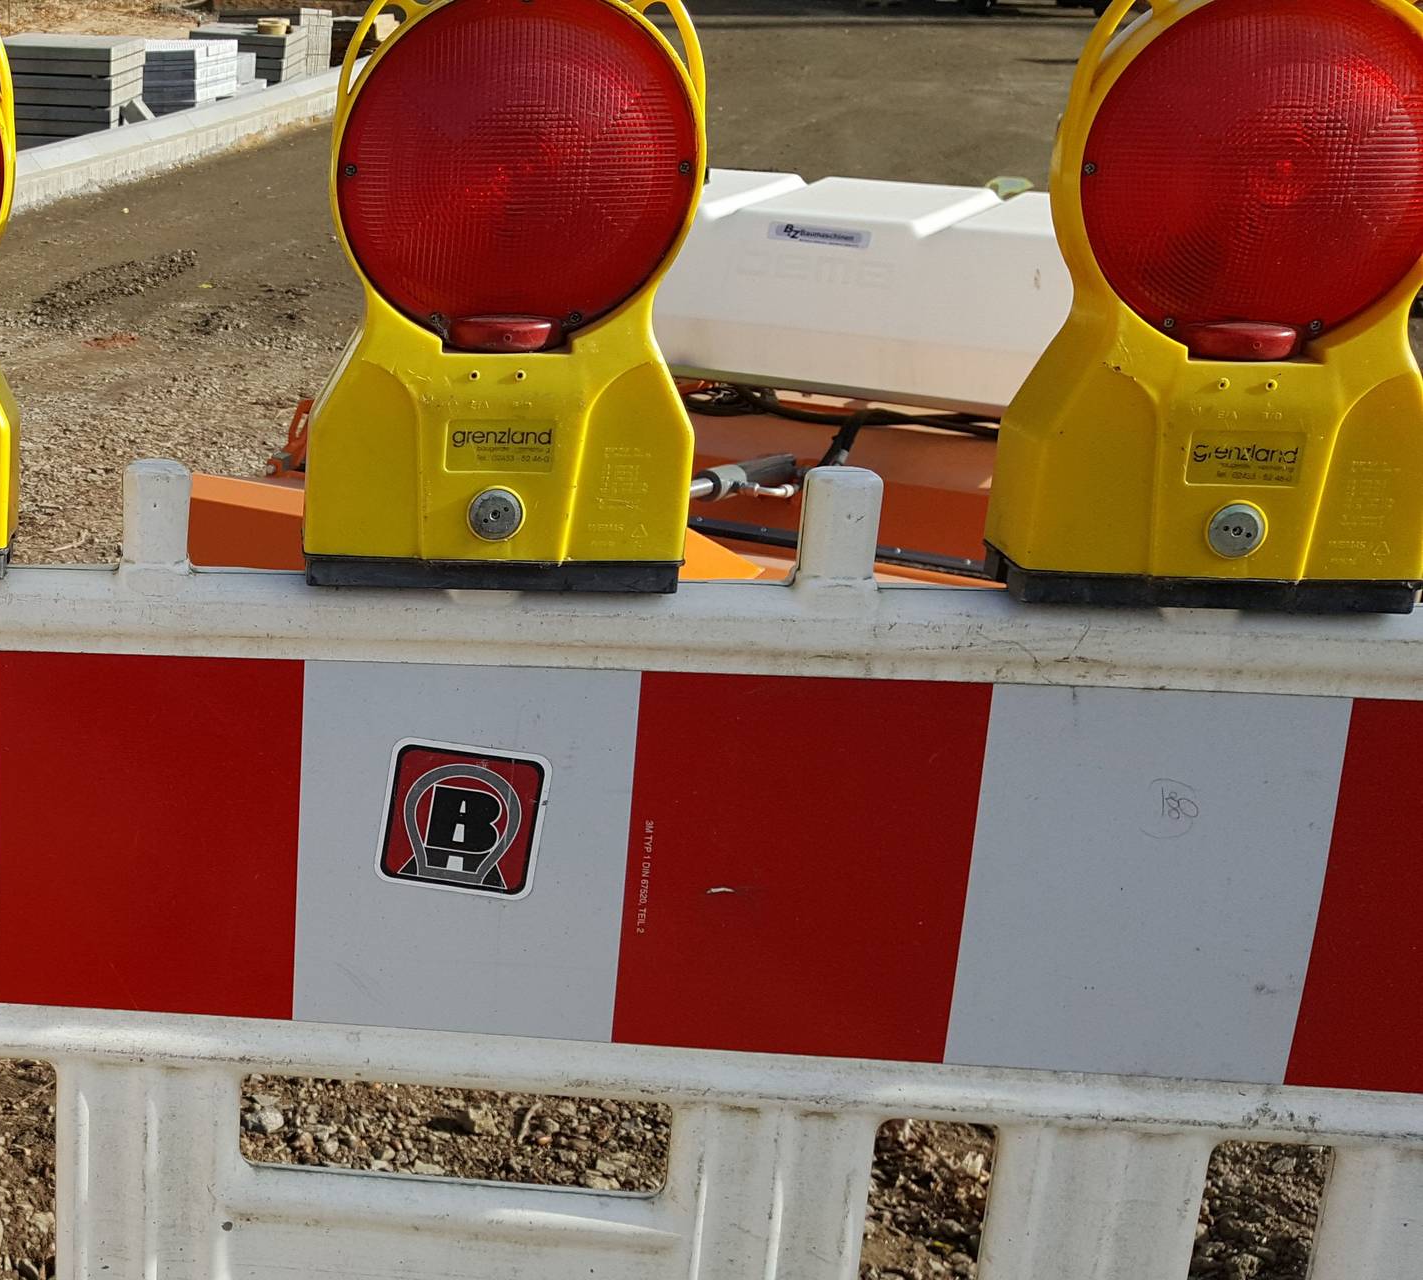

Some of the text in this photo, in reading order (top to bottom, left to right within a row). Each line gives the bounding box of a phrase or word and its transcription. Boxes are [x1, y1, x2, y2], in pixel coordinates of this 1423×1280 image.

[452, 428, 553, 448] grenzland
[645, 819, 654, 833] 3M
[643, 835, 653, 853] TYP
[641, 862, 651, 878] DIN
[637, 907, 647, 926] TEIL
